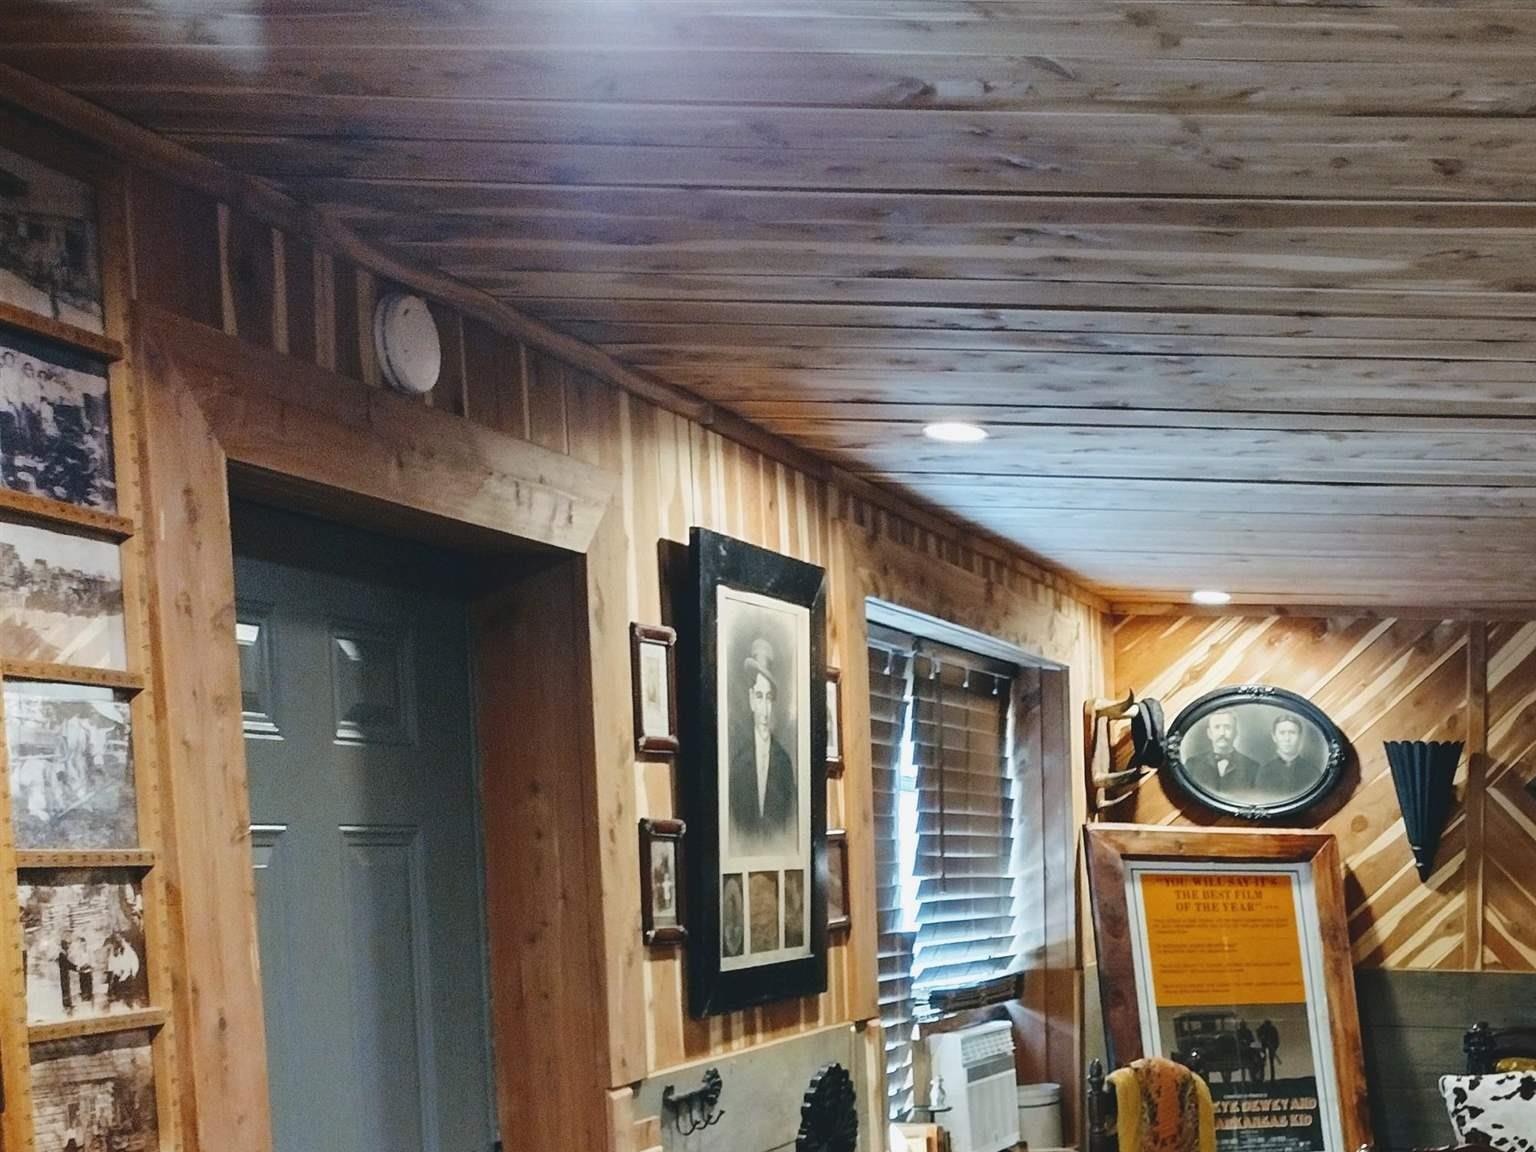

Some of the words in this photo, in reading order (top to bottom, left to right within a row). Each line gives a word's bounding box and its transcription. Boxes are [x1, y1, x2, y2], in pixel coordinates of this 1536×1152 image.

[1193, 875, 1225, 887] WILL
[1175, 889, 1199, 899] THE
[1203, 889, 1231, 899] BEST
[1235, 889, 1263, 899] FILM
[1176, 902, 1191, 912] OF
[1195, 902, 1220, 912] THE
[1290, 1097, 1317, 1110] AND
